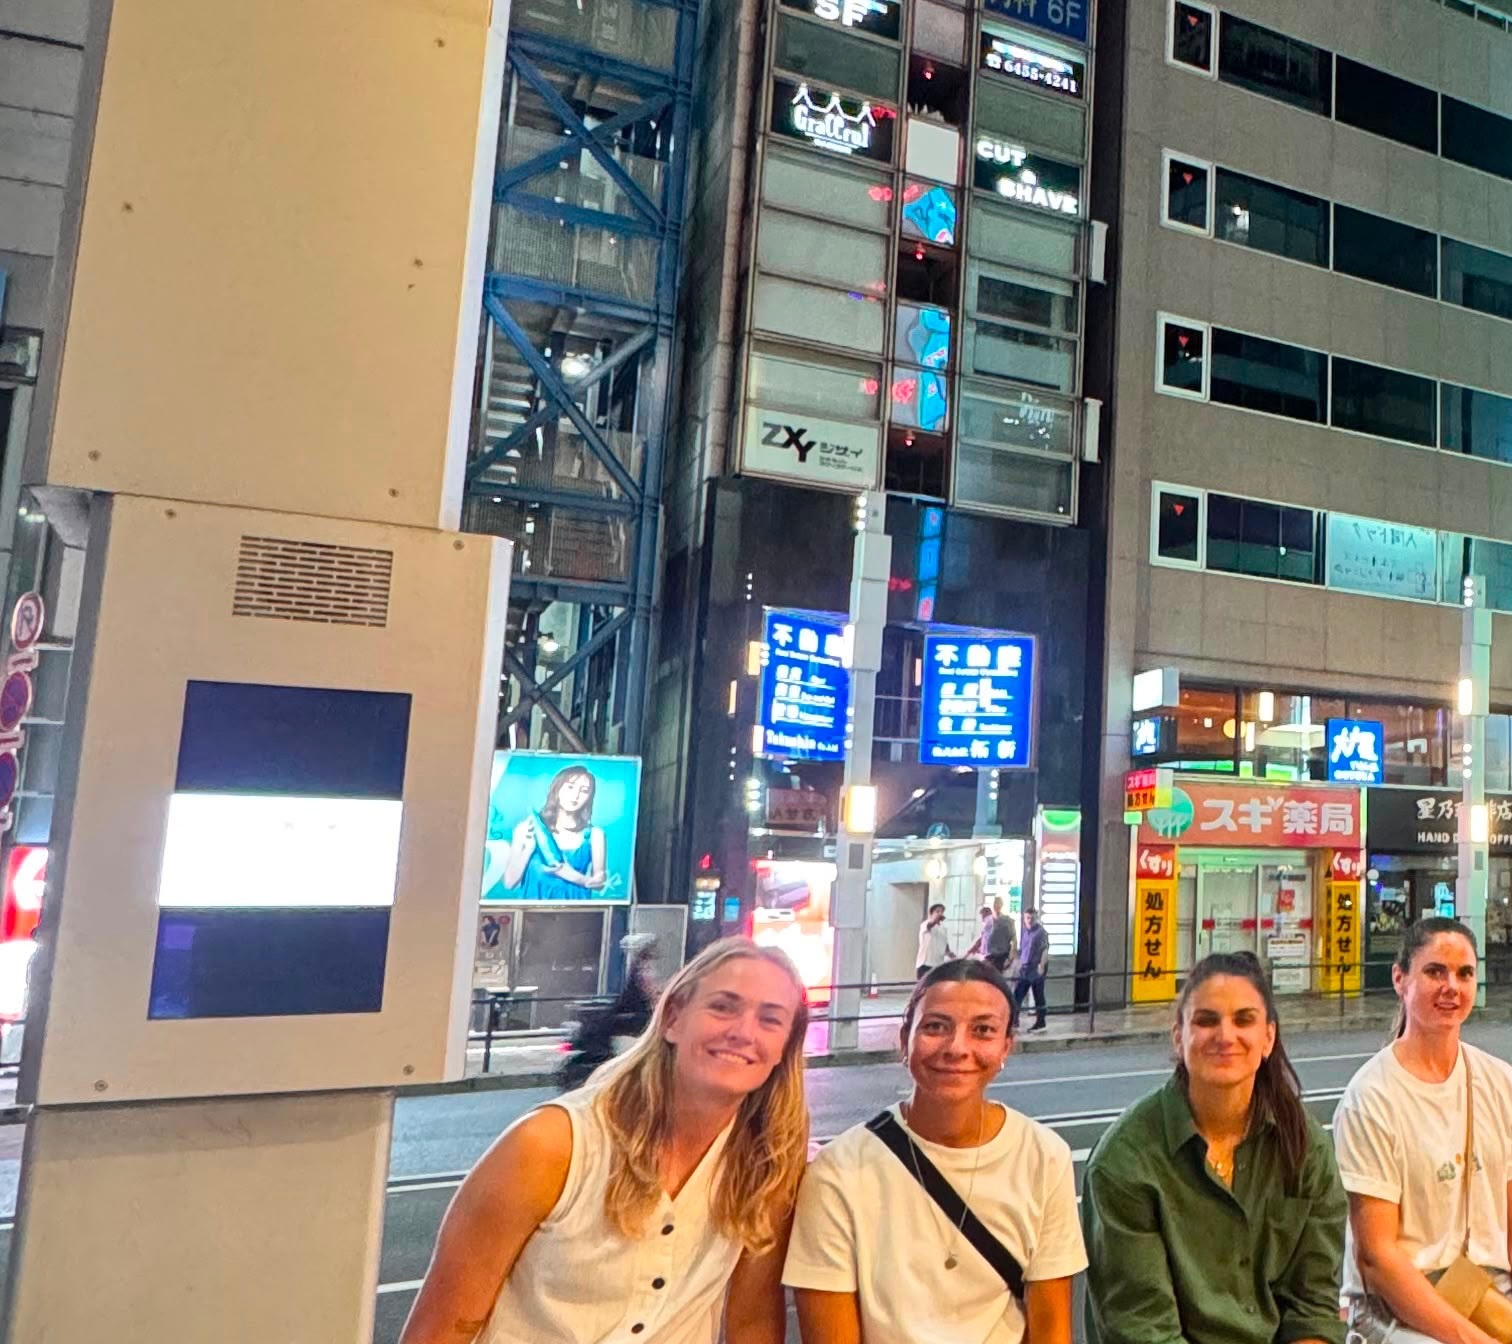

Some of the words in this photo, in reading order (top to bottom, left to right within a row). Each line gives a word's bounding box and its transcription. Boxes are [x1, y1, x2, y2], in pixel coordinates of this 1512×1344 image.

[977, 140, 1027, 167] CUT
[761, 421, 817, 463] ZXY
[1200, 795, 1354, 836] スギ薬局
[1417, 832, 1450, 845] HAND
[1139, 849, 1173, 876] くすり
[1143, 891, 1164, 979] 処方せん
